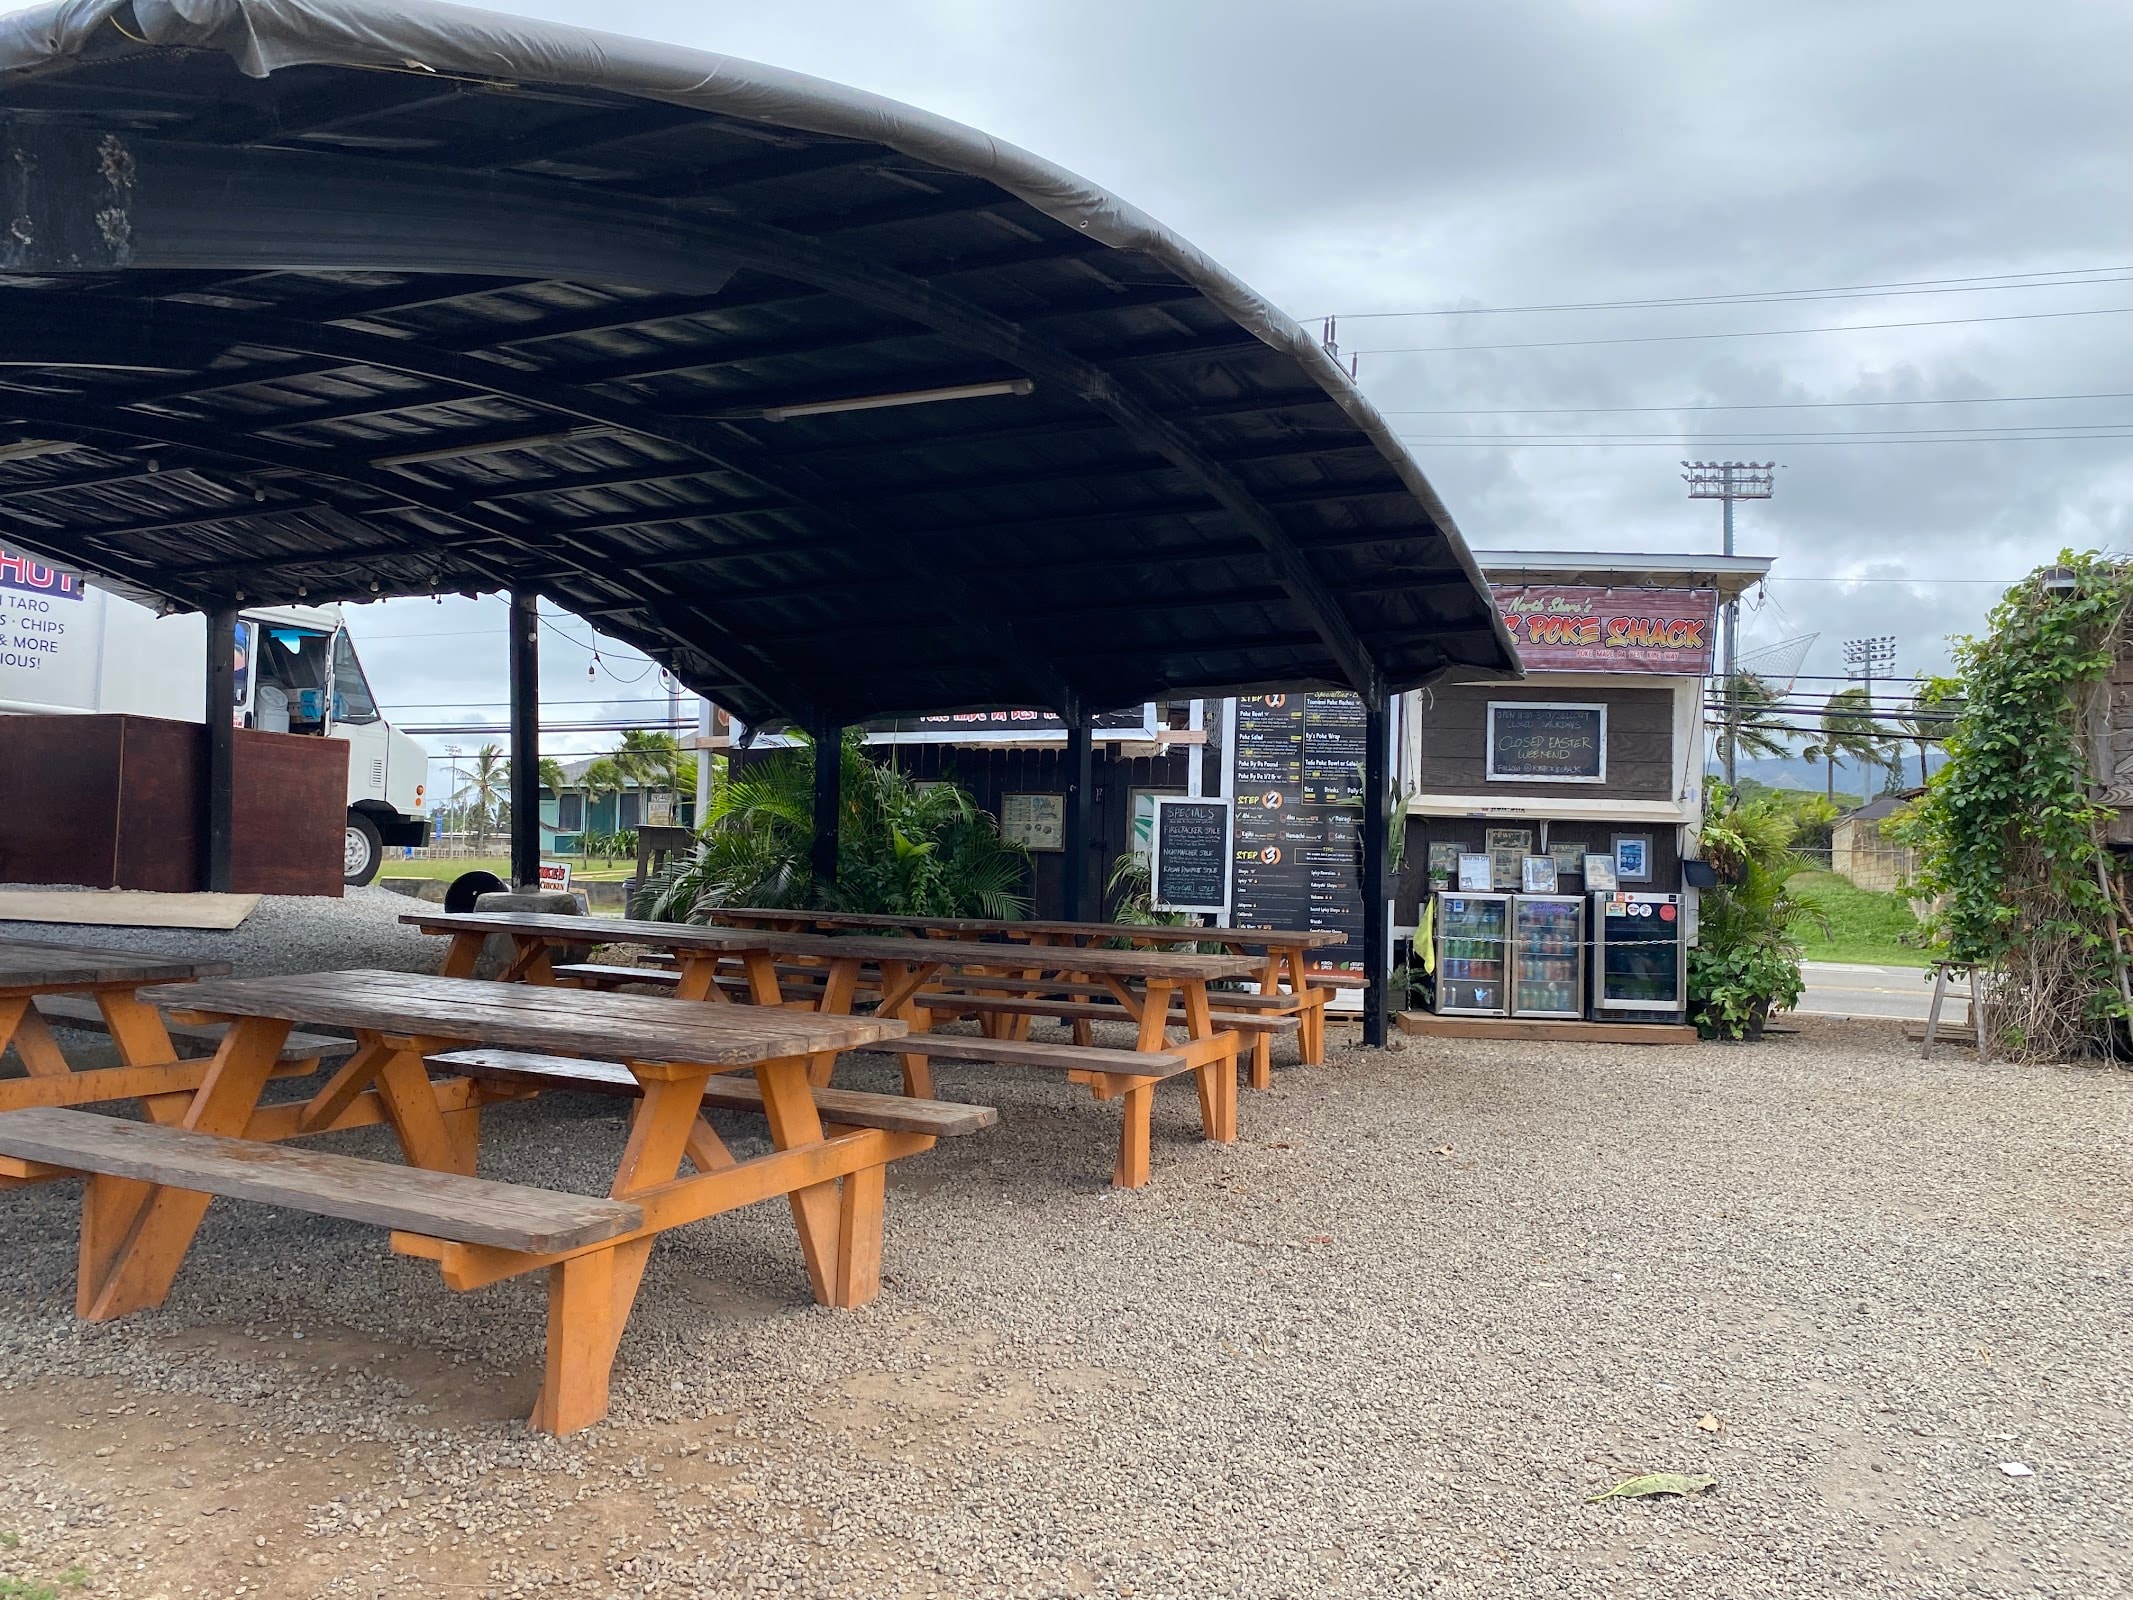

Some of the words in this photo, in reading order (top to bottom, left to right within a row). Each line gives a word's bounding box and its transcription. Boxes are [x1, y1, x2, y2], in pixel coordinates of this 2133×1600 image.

[8, 596, 49, 613] TARO
[1508, 596, 1544, 612] North
[1548, 597, 1592, 613] Shore's
[21, 618, 65, 634] CHIPS
[1526, 615, 1600, 645] POKE
[1606, 617, 1705, 648] SHACK
[14, 636, 58, 653] MORE
[1499, 736, 1544, 751] CLOSED
[1549, 737, 1592, 749] EASTER
[1518, 749, 1570, 759] WEEKEND
[1237, 796, 1260, 804] STEP
[1167, 807, 1215, 819] SPECIALS
[1164, 825, 1203, 835] FIRECRACKER
[1236, 851, 1258, 859] STEP
